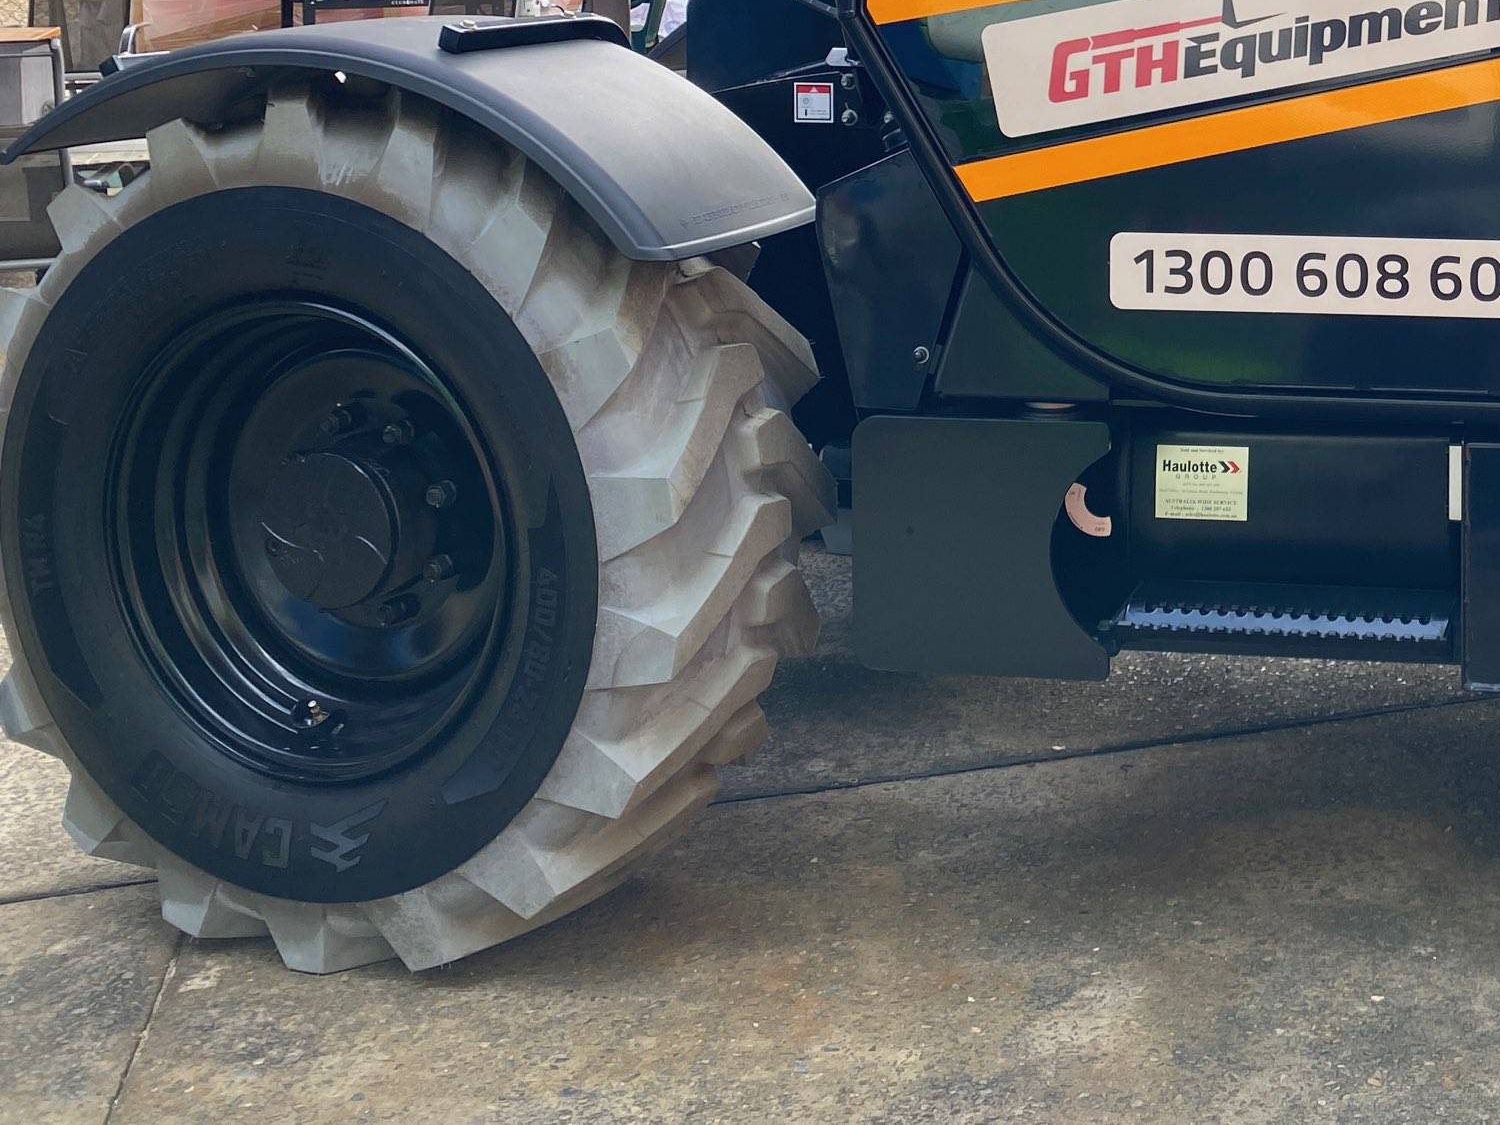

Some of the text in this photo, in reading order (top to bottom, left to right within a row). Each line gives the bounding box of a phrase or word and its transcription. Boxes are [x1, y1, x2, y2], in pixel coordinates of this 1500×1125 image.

[1133, 249, 1273, 297] 1300
[1295, 252, 1410, 300] 608
[1162, 459, 1218, 473] Haulotte
